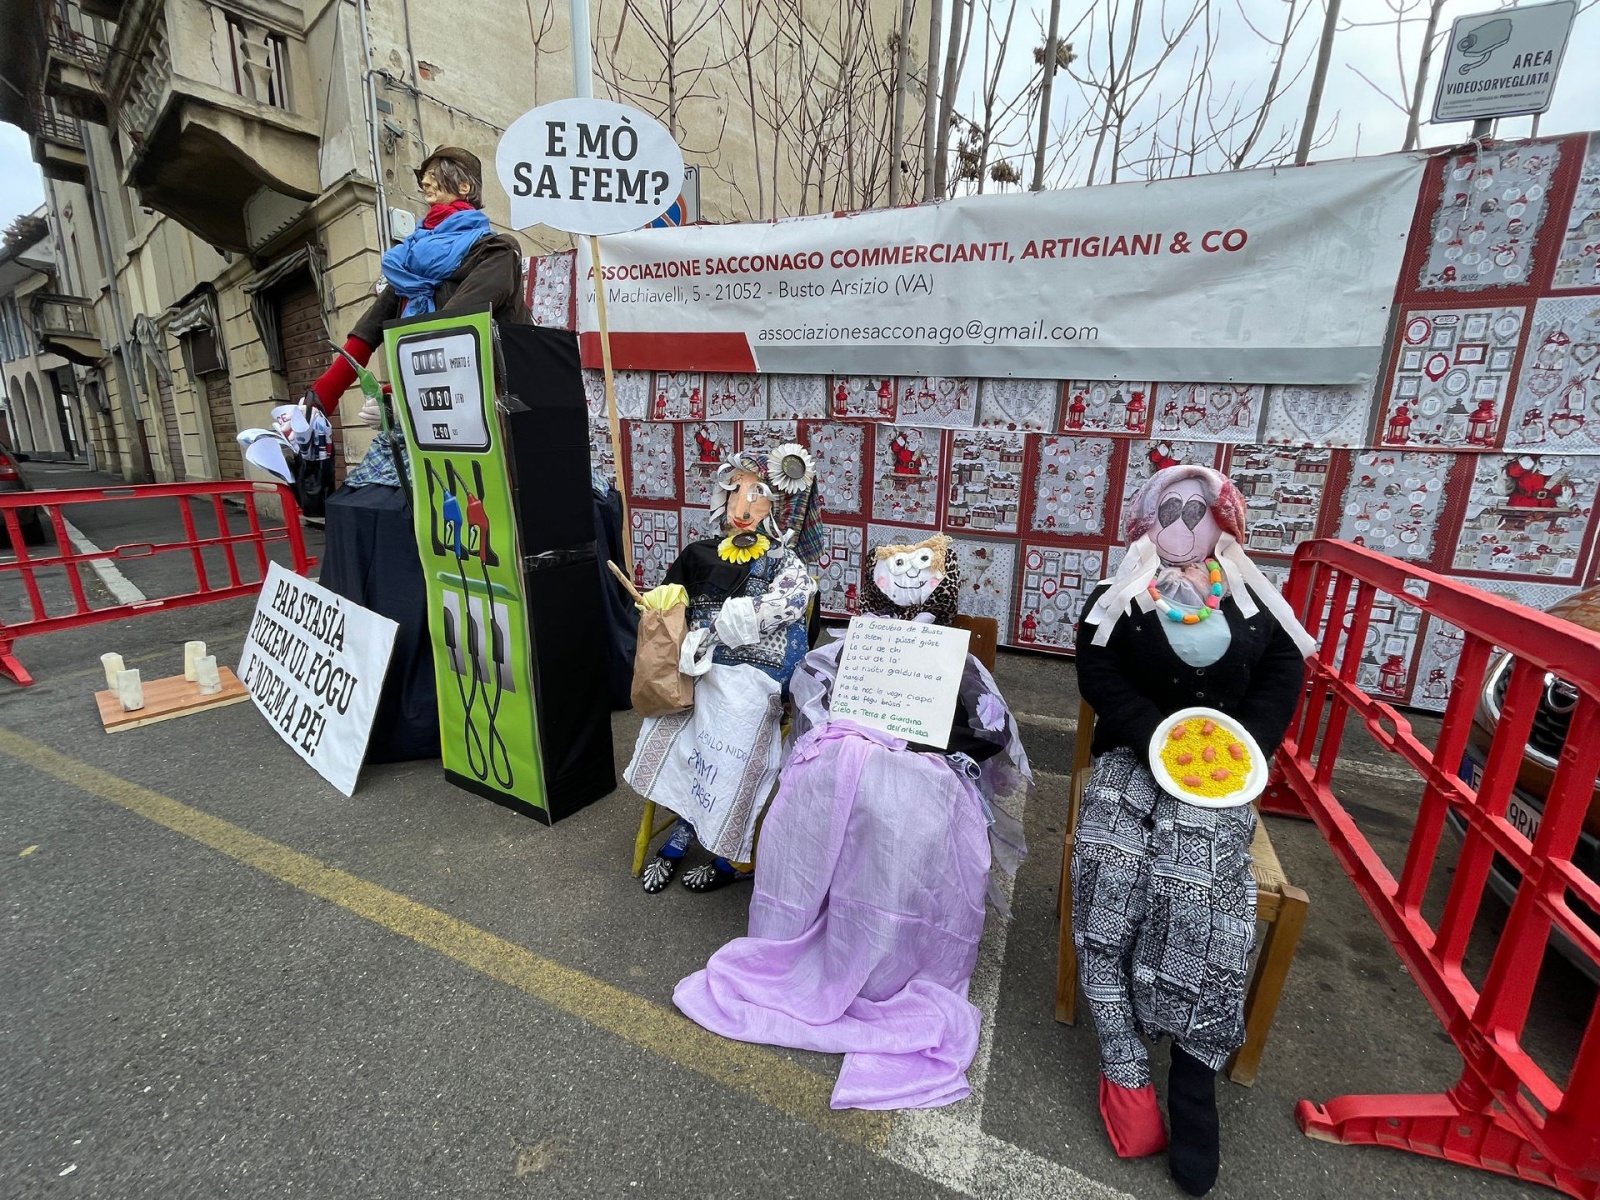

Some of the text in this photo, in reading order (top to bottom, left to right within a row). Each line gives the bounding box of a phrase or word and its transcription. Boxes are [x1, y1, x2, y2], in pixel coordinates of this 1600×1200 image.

[1512, 50, 1553, 69] AREA
[1446, 72, 1549, 95] VIDEOSORVEGLIATA
[545, 115, 638, 161] E MÒ
[513, 161, 669, 206] SA FEM?
[587, 228, 1249, 281] ASSOCIAZIONE SACCONAGO COMMERCIANTI, ARTIGIANI & CO
[609, 285, 688, 304] Machiavelli,
[693, 285, 700, 302] 5
[715, 281, 762, 301] 21052
[778, 279, 826, 298] Busto
[831, 276, 889, 297] Arsizio
[895, 272, 934, 297] (VA)
[758, 319, 1099, 345] associazionesacconago@gmail.com
[413, 352, 444, 371] 0125
[272, 579, 298, 620] PAR
[252, 610, 358, 715] PIZZEM UL FÖGU
[280, 694, 299, 733] A
[292, 704, 326, 757] PÉ!
[832, 706, 851, 714] Cielo
[860, 708, 878, 719] Terra
[890, 714, 922, 726] Giardino
[726, 744, 748, 762] NIDO
